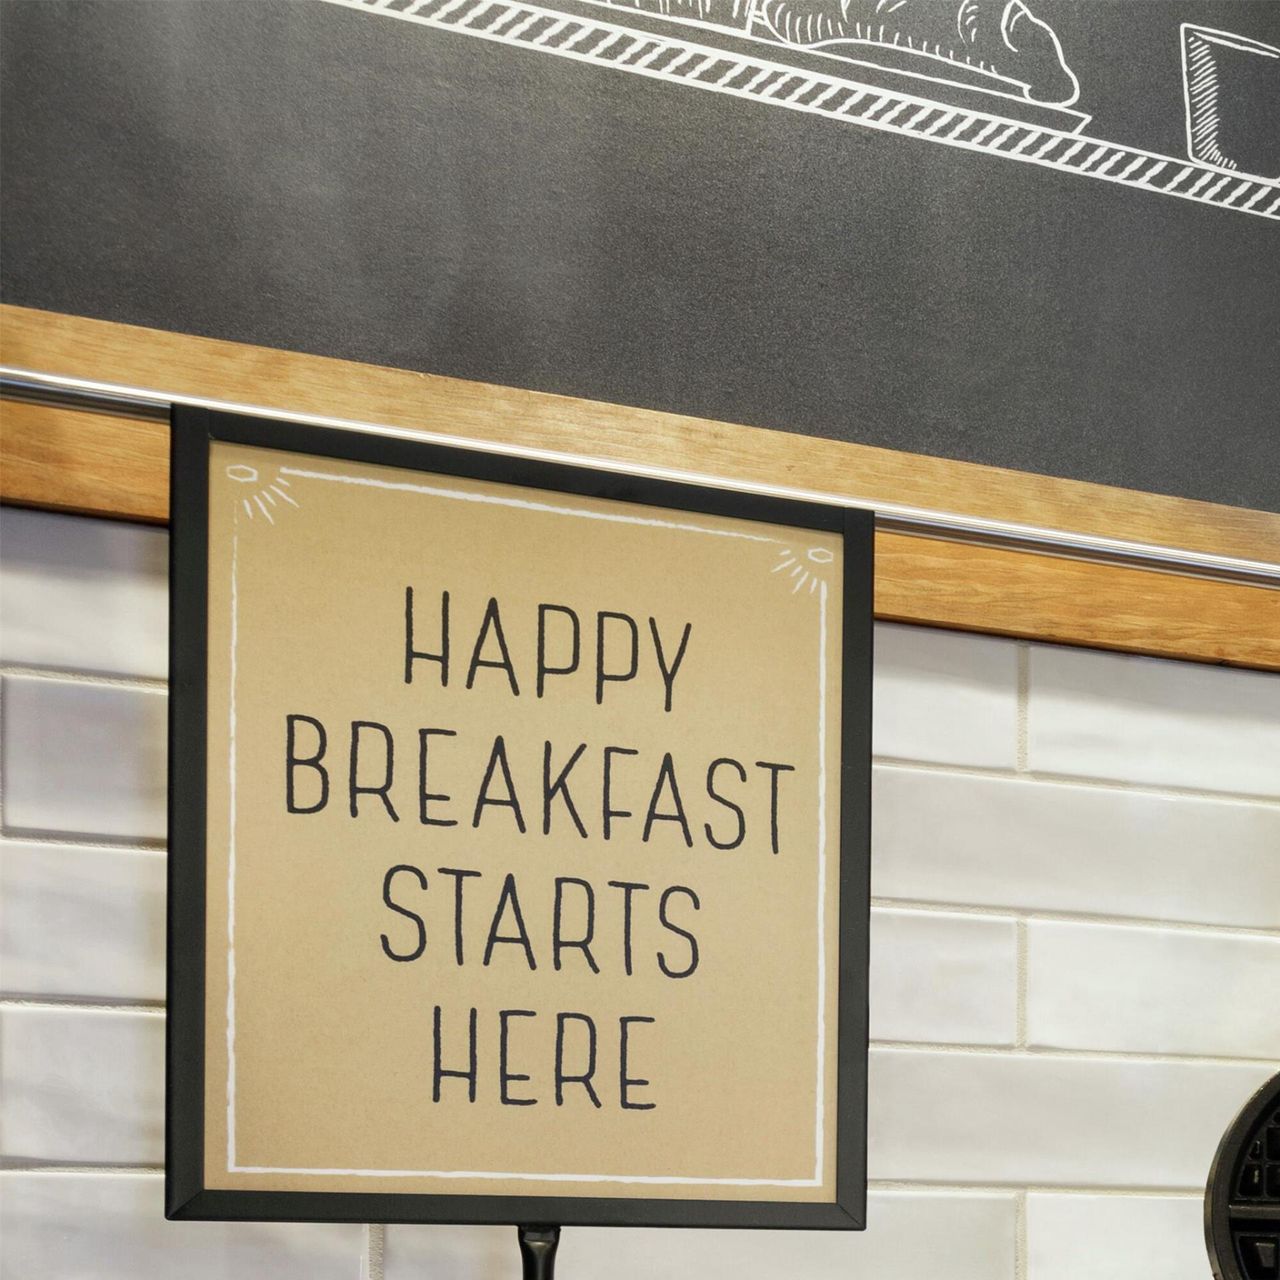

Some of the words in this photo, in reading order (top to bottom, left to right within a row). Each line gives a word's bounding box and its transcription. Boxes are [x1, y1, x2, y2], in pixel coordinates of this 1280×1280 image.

[403, 585, 693, 712] HAPPY
[286, 713, 795, 855] BREAKFAST
[380, 864, 701, 980] STARTS
[431, 1004, 657, 1110] HERE
